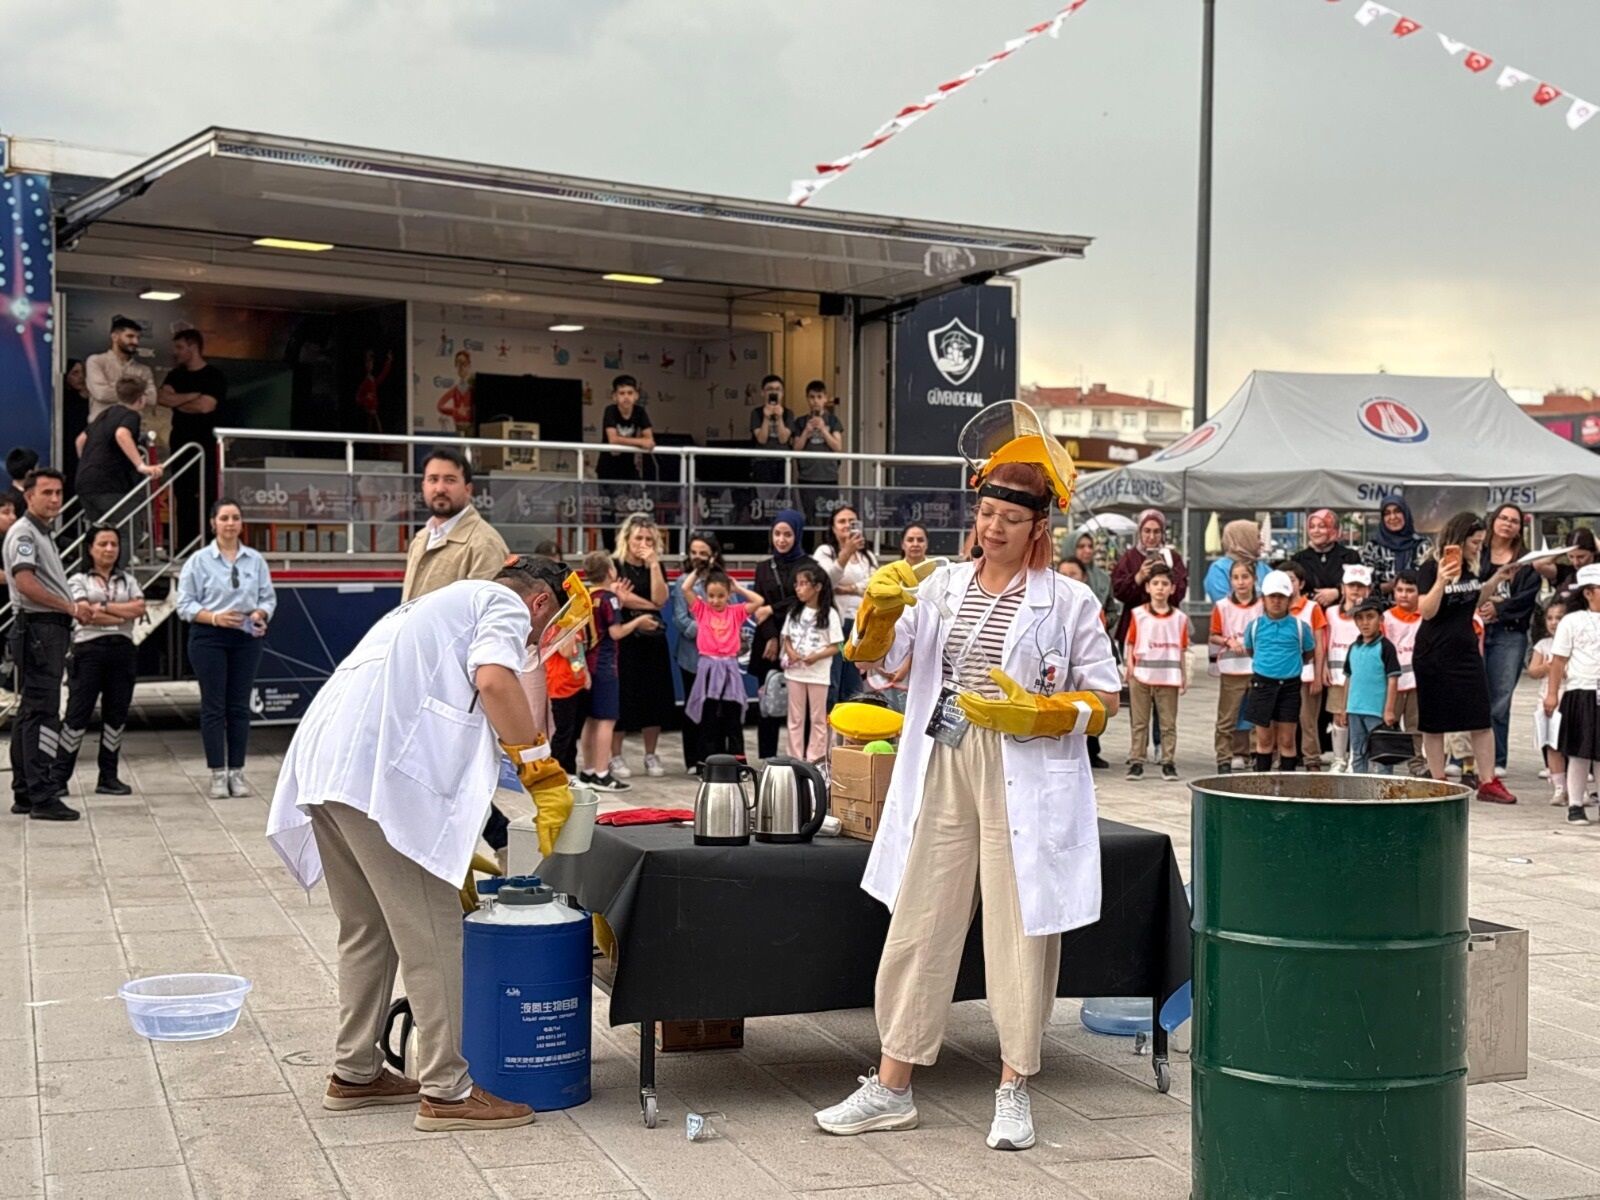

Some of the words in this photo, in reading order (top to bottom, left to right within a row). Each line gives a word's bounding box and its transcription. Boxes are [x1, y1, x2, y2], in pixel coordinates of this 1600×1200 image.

[255, 482, 289, 505] esb
[627, 491, 654, 511] esb
[1487, 486, 1537, 504] İYESİ
